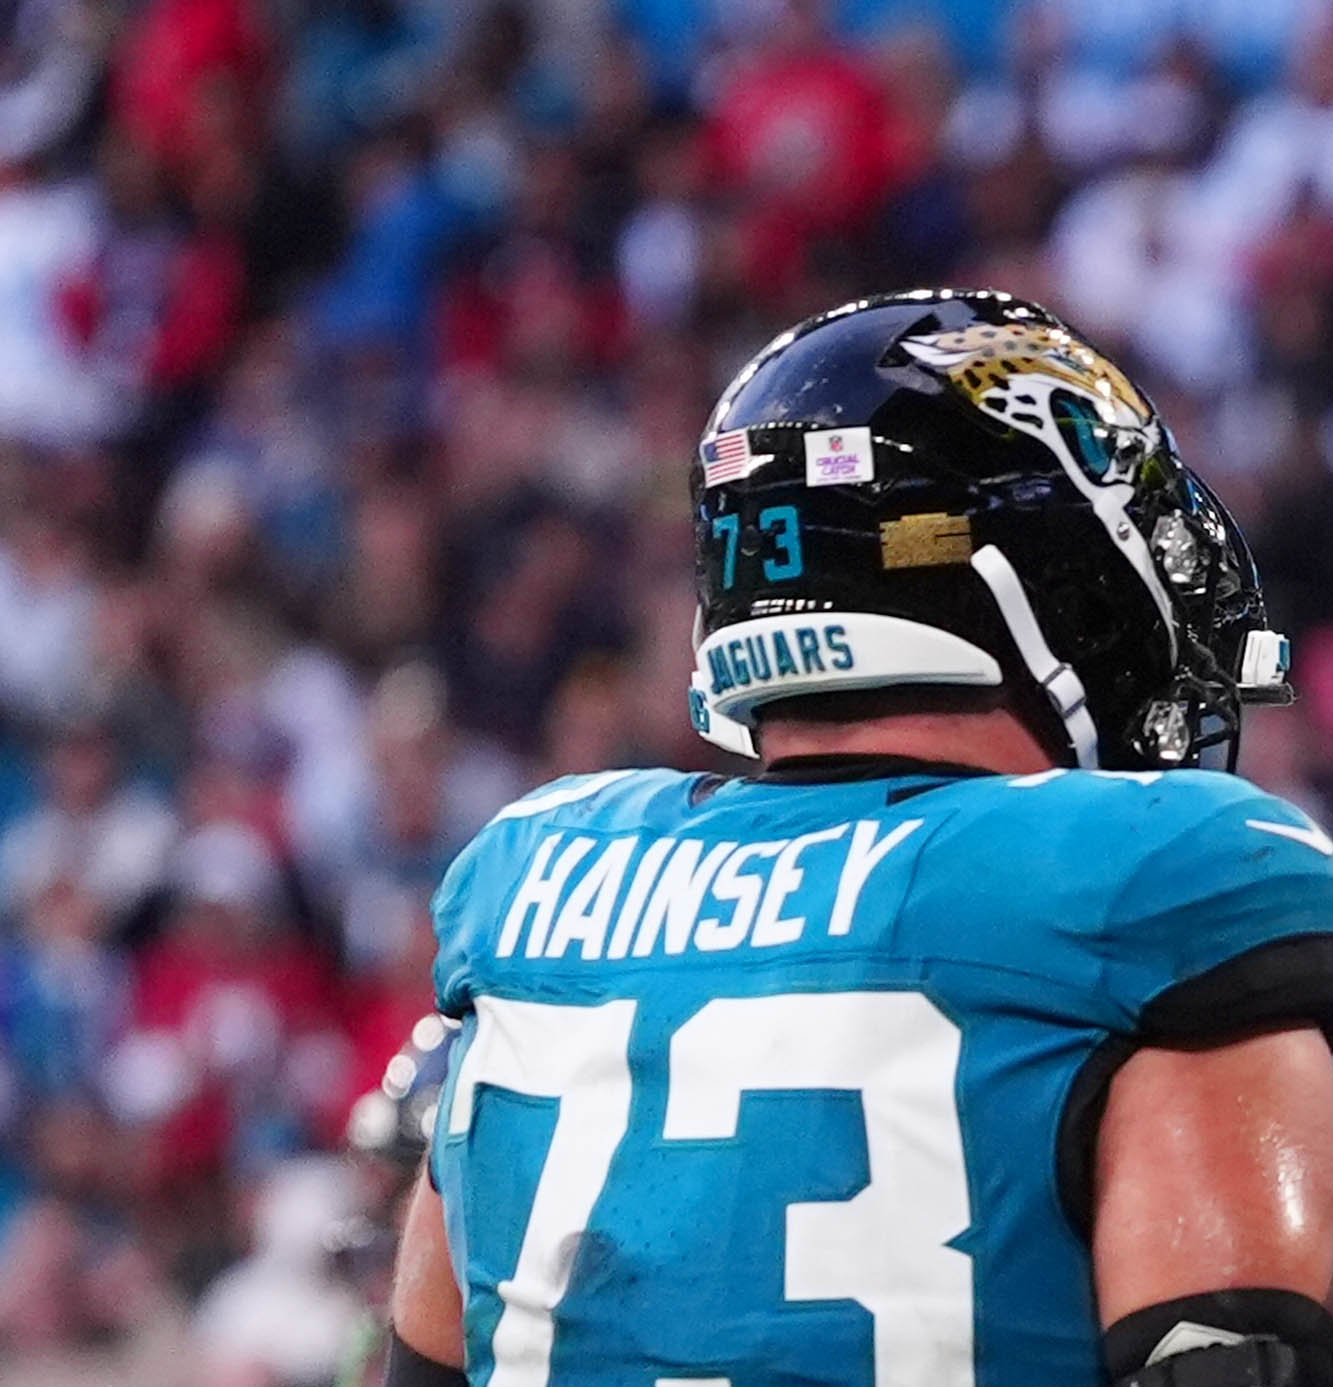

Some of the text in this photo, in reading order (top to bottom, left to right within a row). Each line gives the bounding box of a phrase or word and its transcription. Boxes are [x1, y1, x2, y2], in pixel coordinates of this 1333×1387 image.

[712, 506, 803, 590] 73
[707, 625, 854, 694] JAGUARS
[496, 818, 924, 960] HAINSEY
